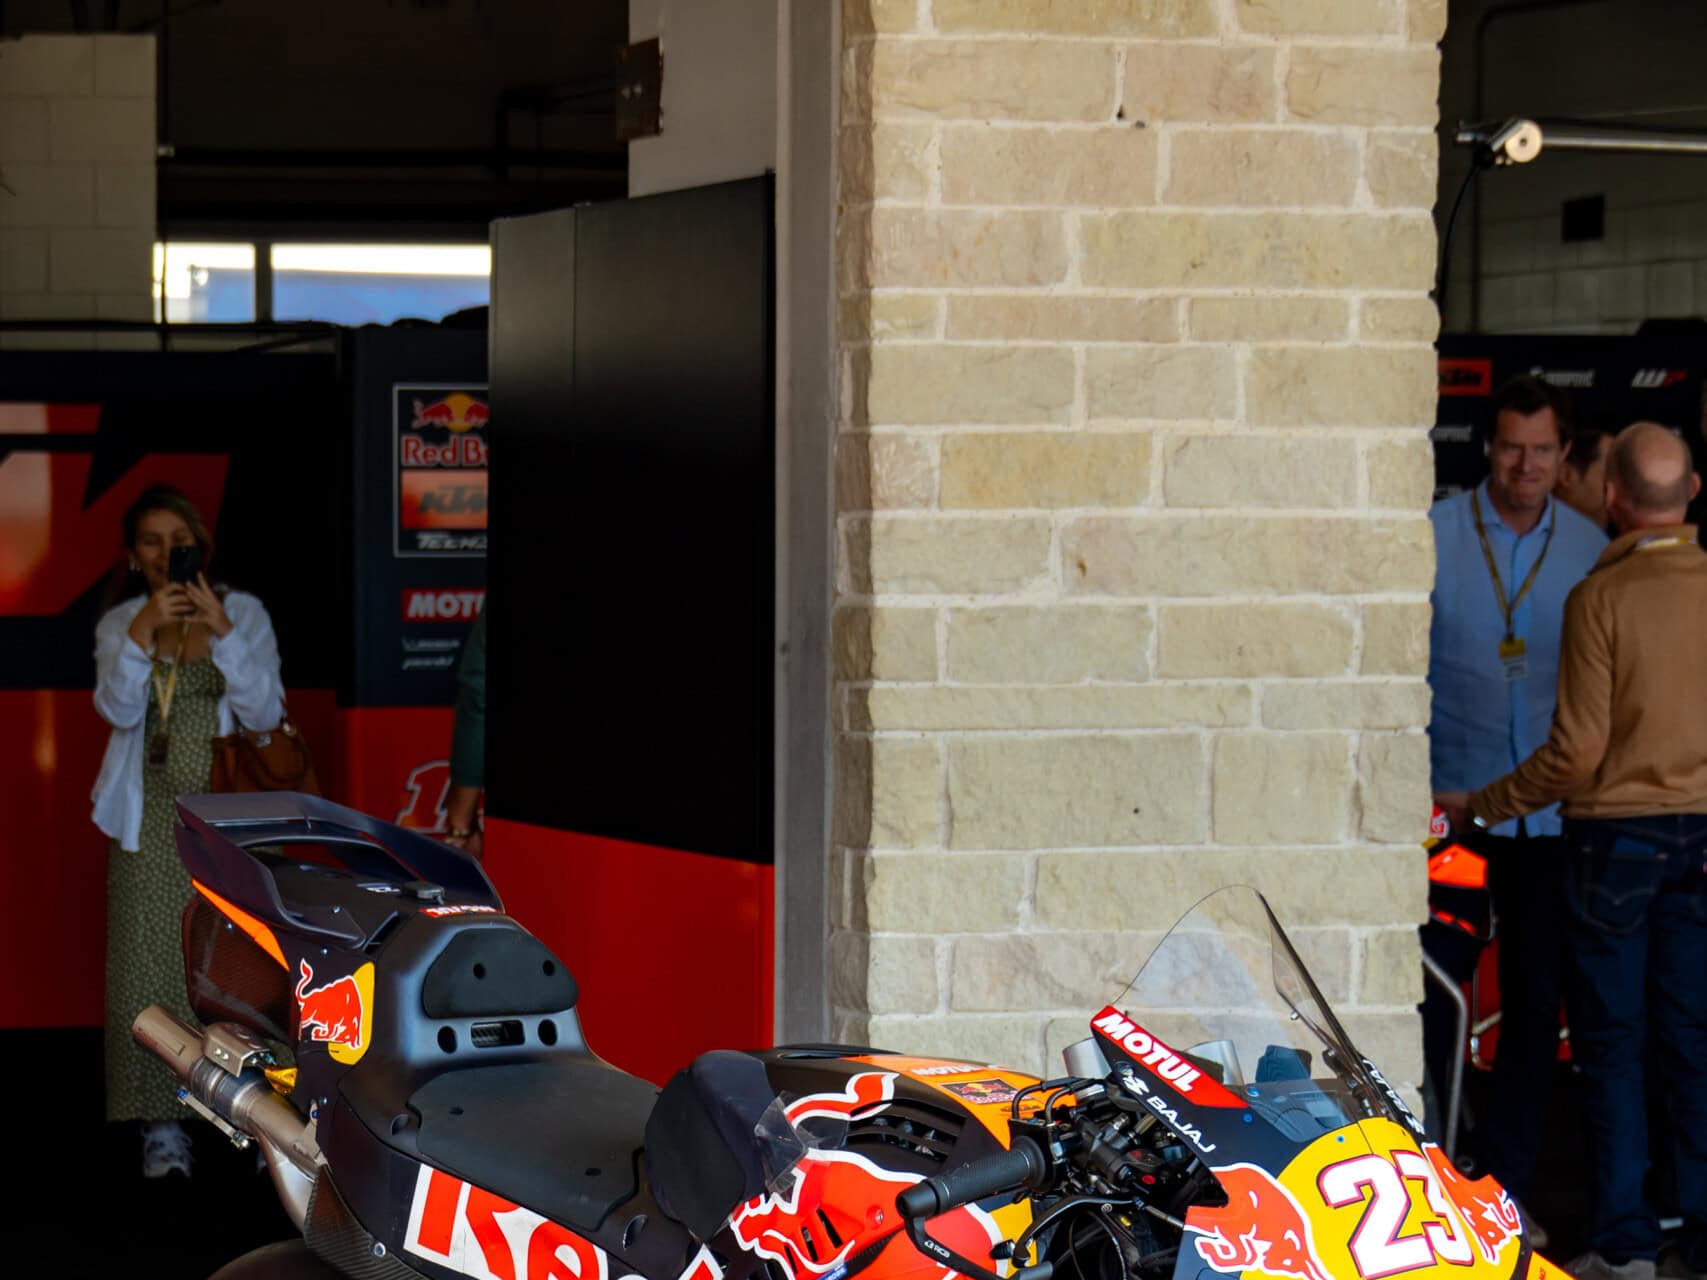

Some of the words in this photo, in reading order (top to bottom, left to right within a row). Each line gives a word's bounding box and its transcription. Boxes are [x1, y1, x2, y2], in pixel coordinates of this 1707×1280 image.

[401, 434, 459, 467] Red
[1093, 1013, 1201, 1092] MOTUL
[1147, 1096, 1216, 1153] BAJAJ
